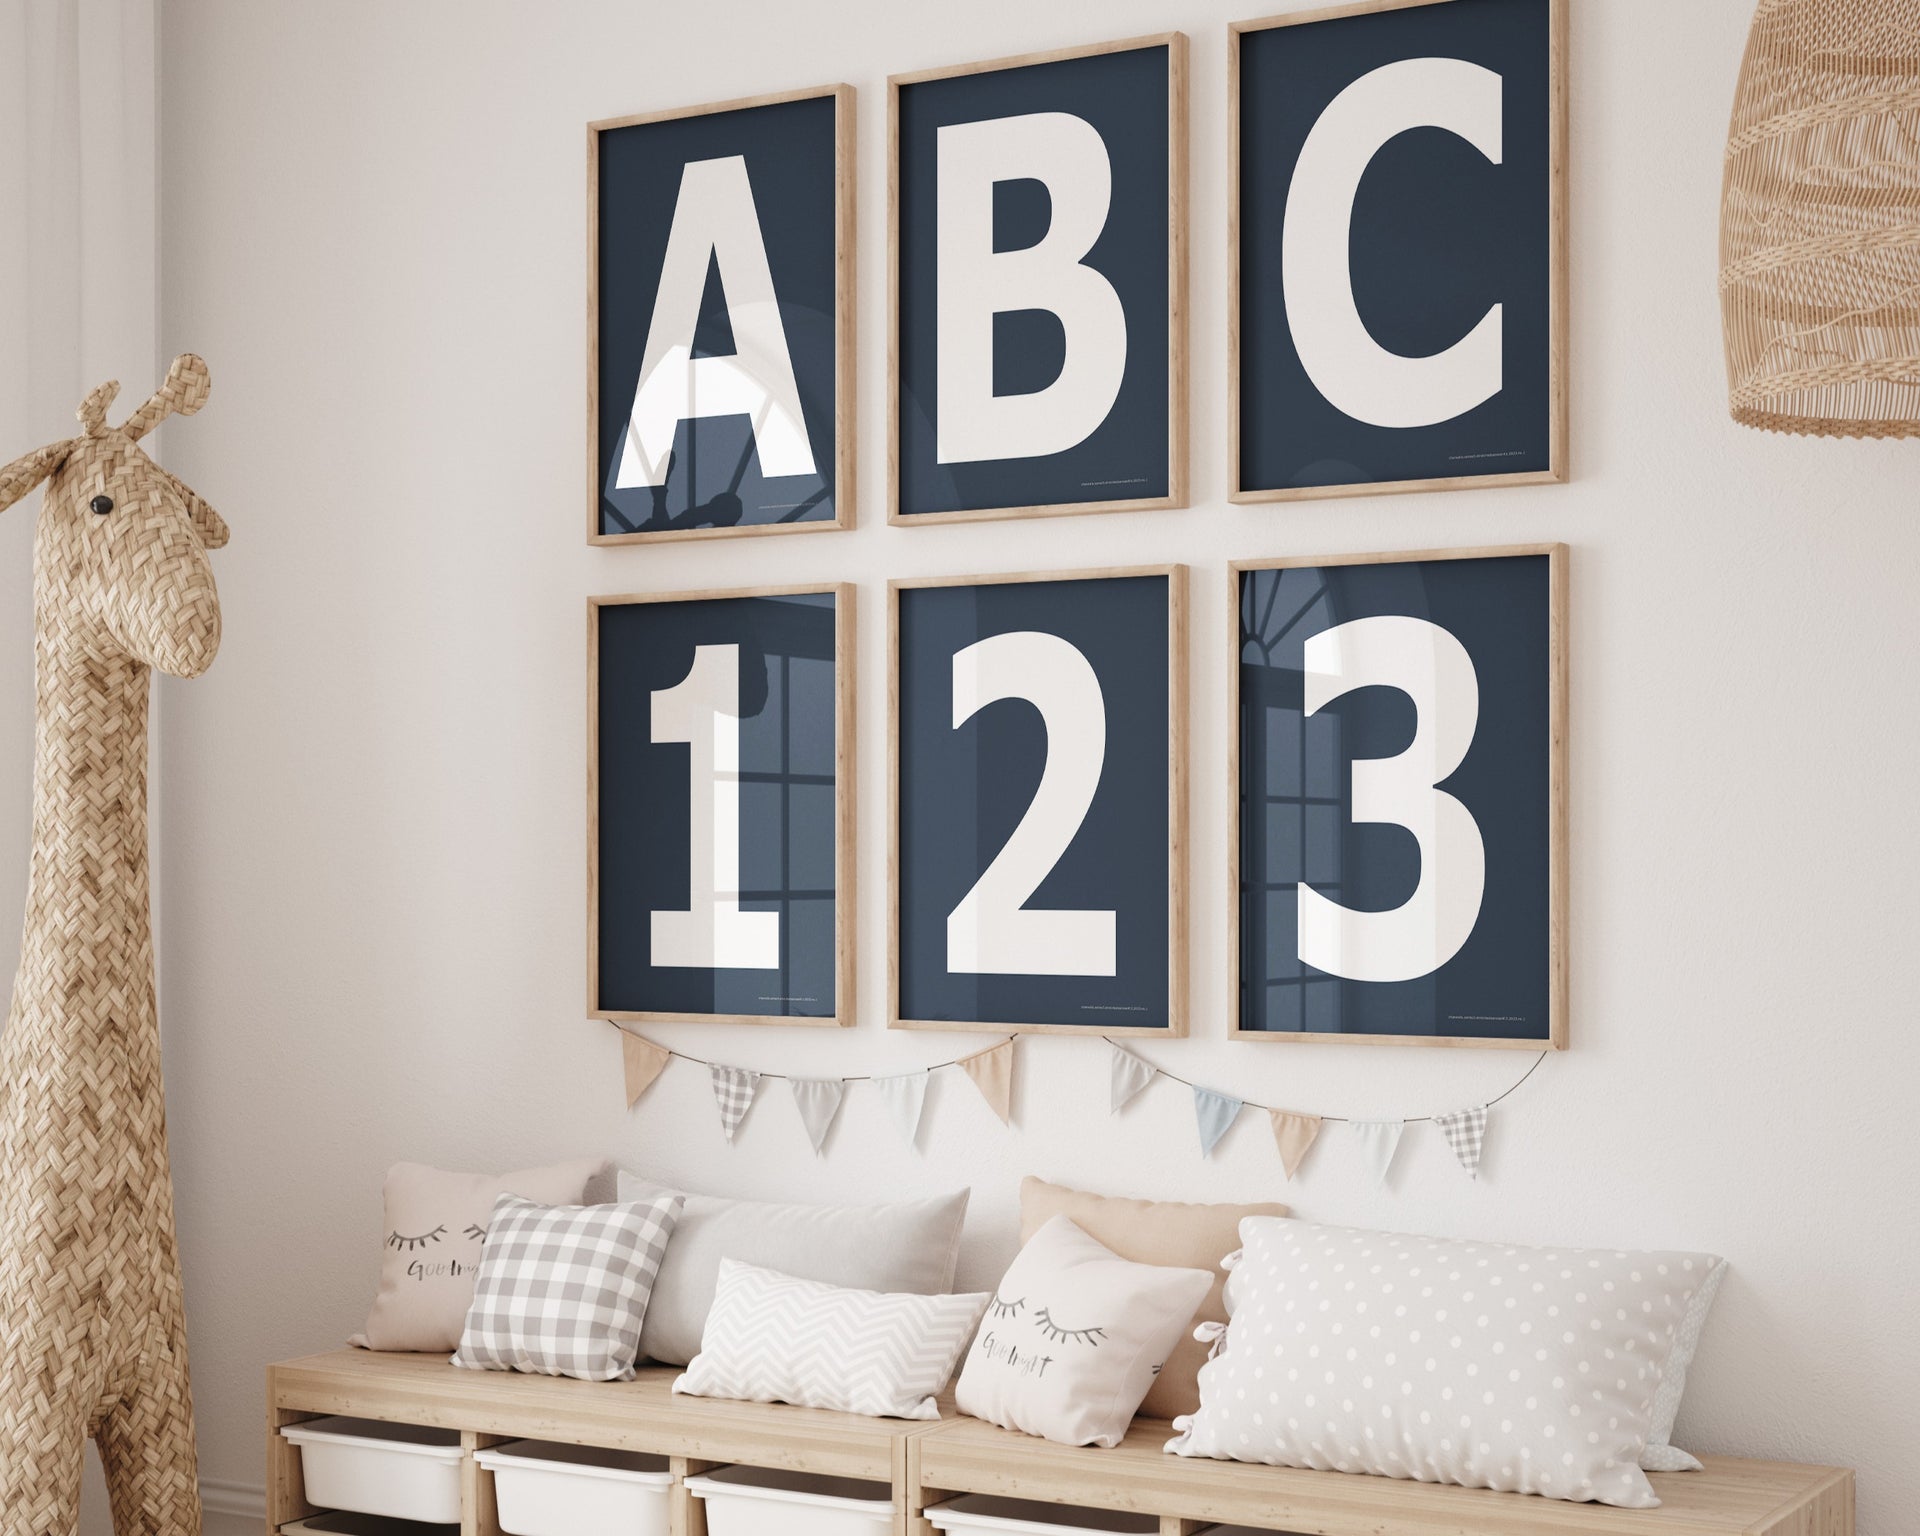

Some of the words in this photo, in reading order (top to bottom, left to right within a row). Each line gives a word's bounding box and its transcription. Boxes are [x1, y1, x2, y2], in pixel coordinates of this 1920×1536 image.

[615, 155, 817, 489] A
[937, 112, 1127, 465] B
[1282, 57, 1502, 429] C
[650, 643, 779, 969] 1
[947, 631, 1116, 977] 2
[1297, 615, 1485, 982] 3
